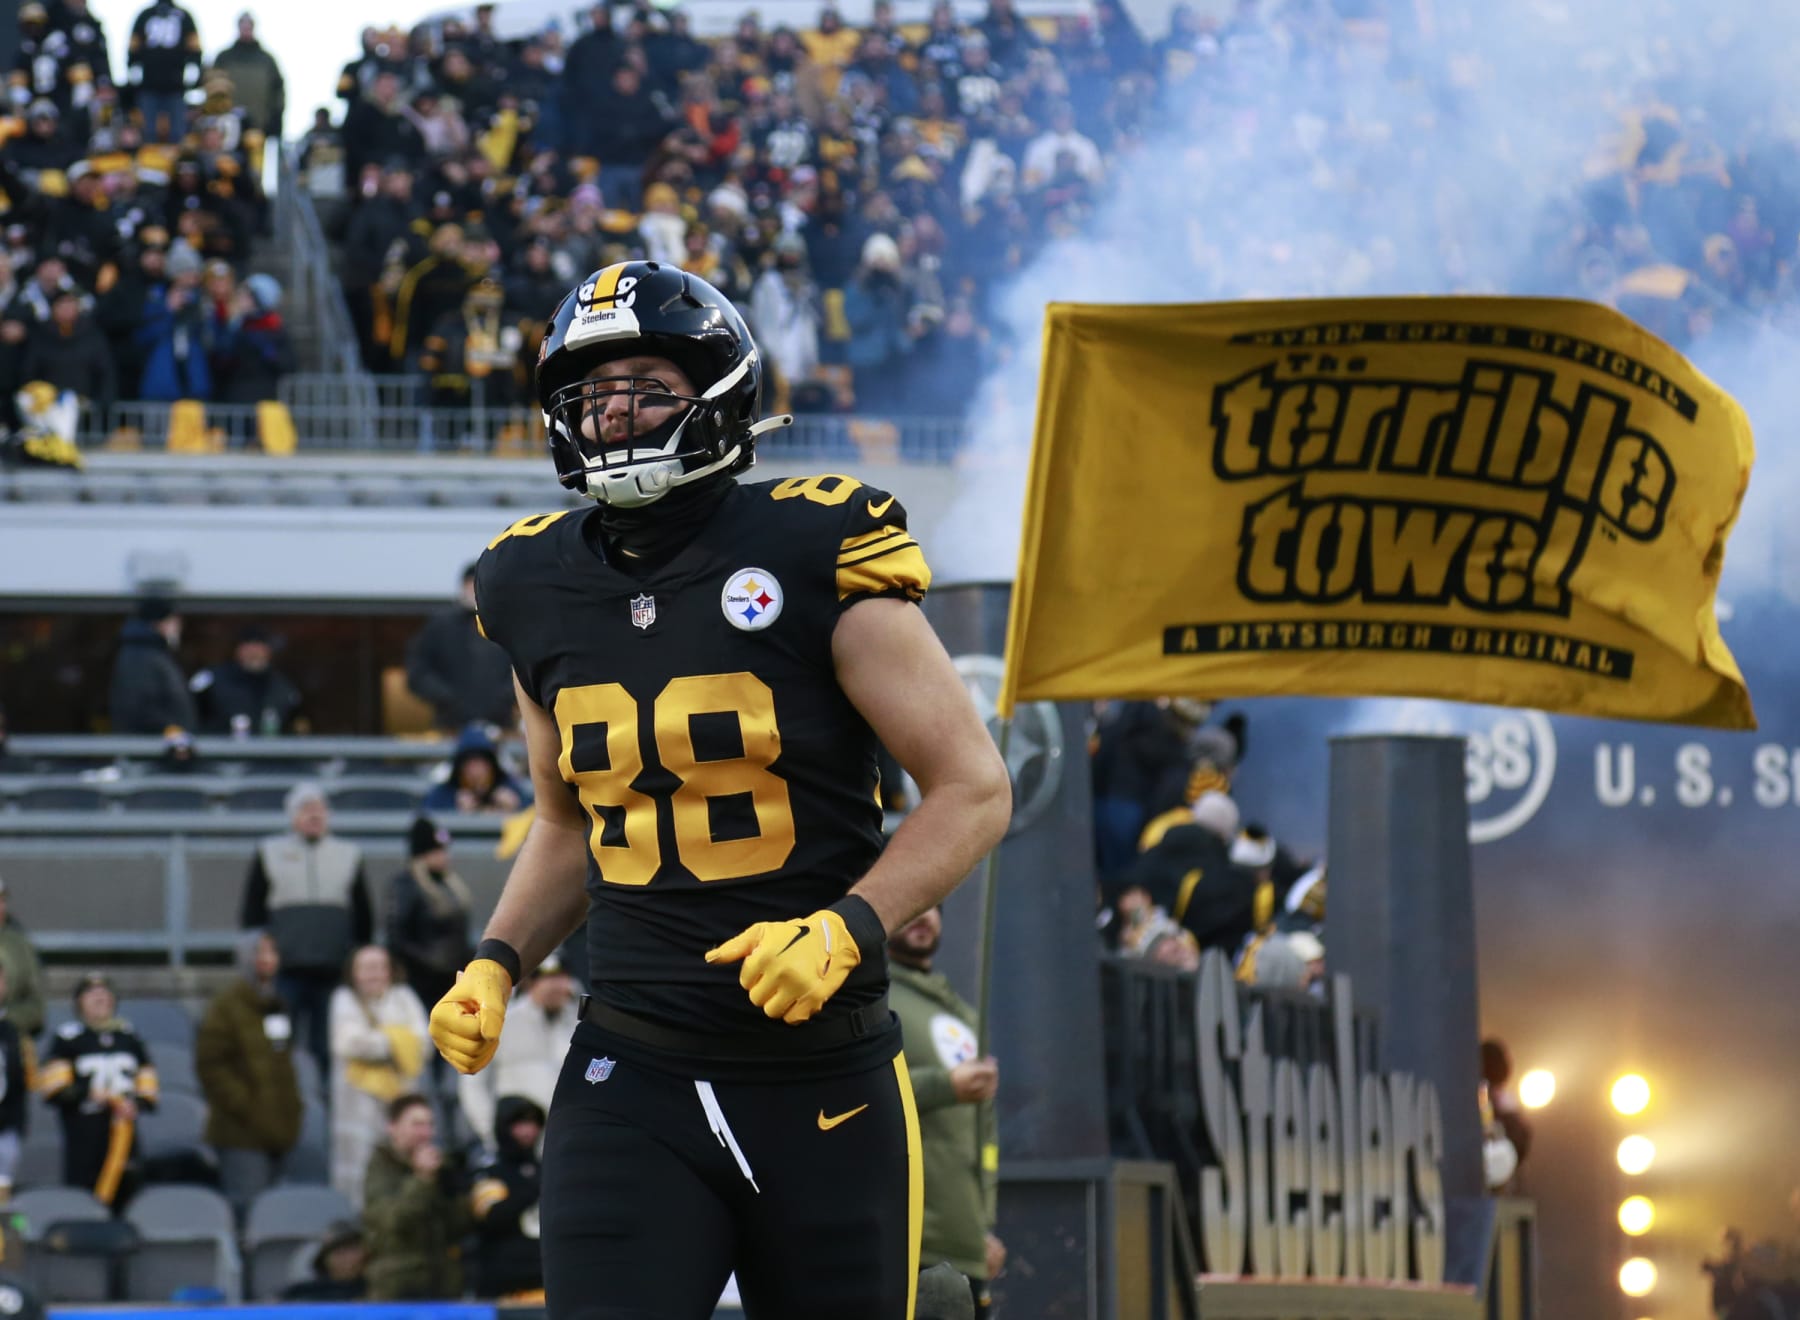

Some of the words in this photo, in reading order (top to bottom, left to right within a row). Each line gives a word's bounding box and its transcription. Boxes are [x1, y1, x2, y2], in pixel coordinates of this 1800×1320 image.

[581, 310, 617, 326] Steelers
[1286, 353, 1368, 373] The
[1529, 330, 1680, 407] OFFICIAL
[1210, 358, 1676, 543] terrible
[1236, 483, 1600, 618] towel
[634, 609, 653, 623] NFL
[726, 594, 751, 604] Steelers
[1180, 626, 1198, 650] A
[1217, 621, 1432, 649] PITTSBURGH
[1451, 631, 1614, 673] ORIGINAL
[553, 671, 796, 887] 88
[1195, 945, 1446, 1283] Steelers
